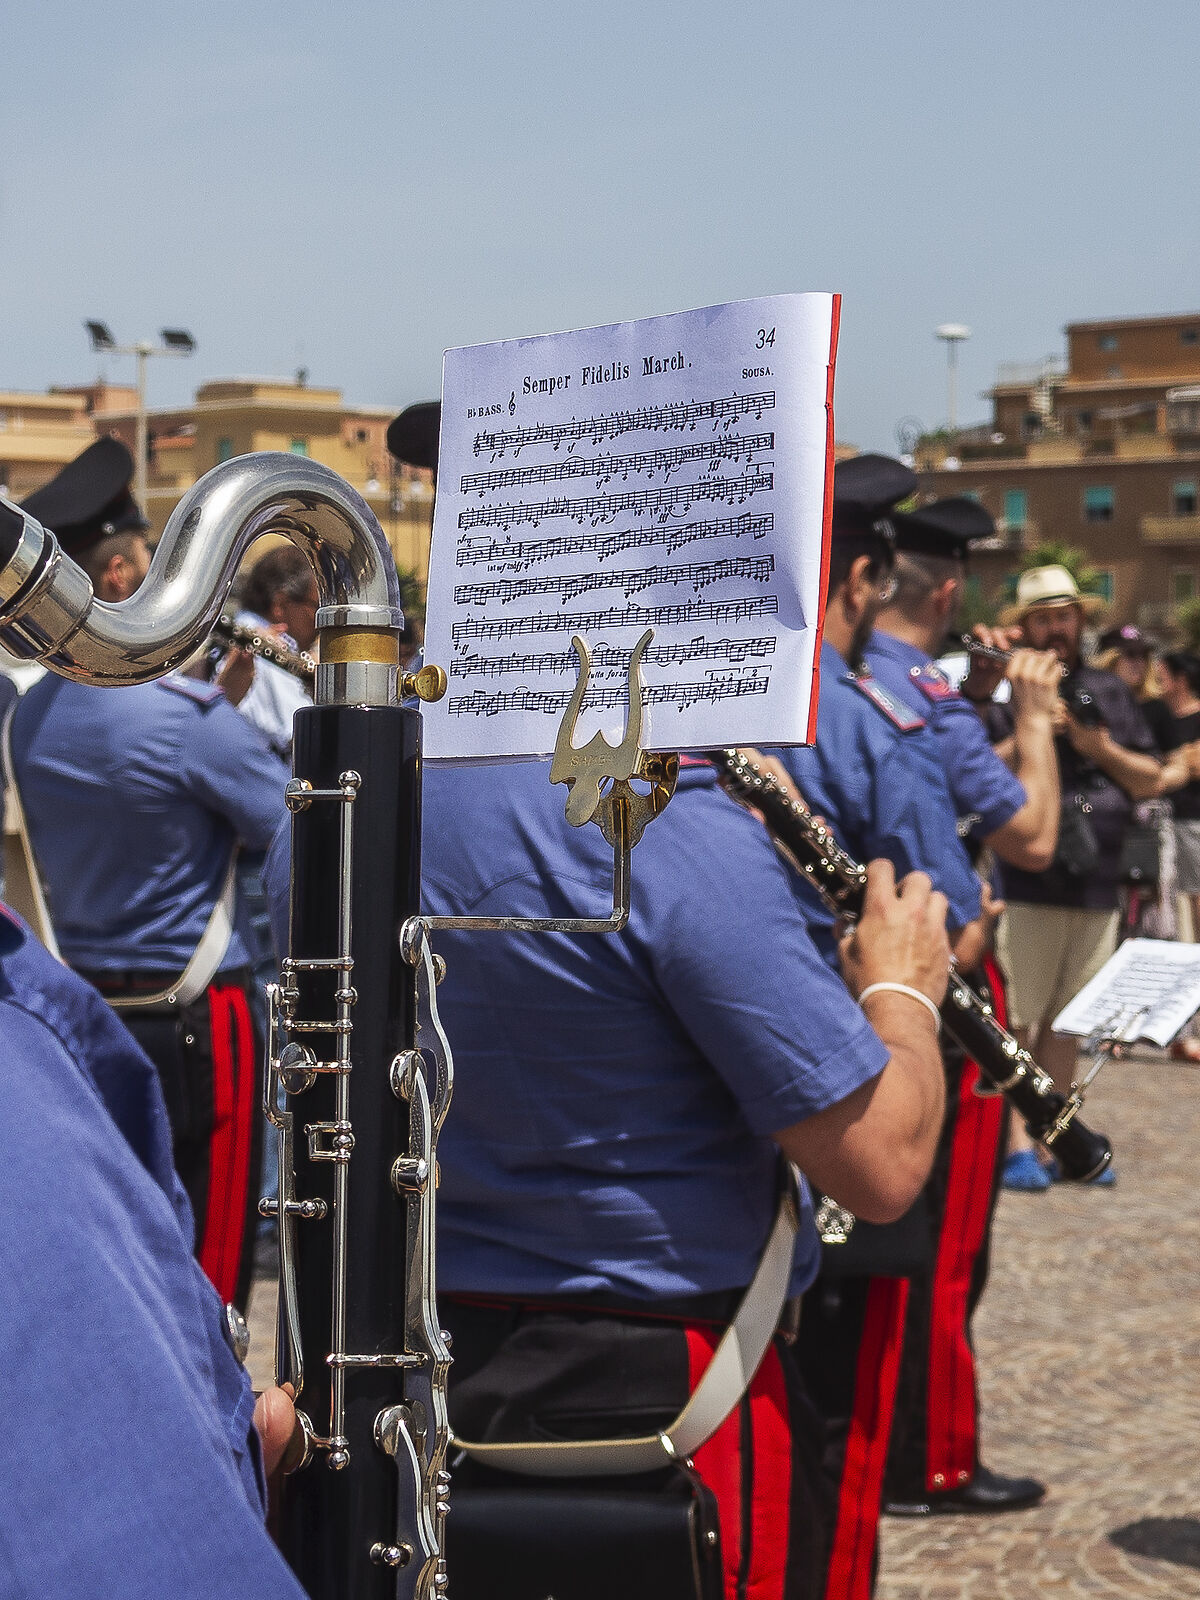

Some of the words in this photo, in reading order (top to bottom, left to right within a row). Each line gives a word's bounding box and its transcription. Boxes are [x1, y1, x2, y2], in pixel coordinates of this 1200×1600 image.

[755, 327, 776, 349] 34
[522, 374, 571, 395] Semper
[581, 362, 630, 386] Fidelis
[642, 351, 692, 377] March.
